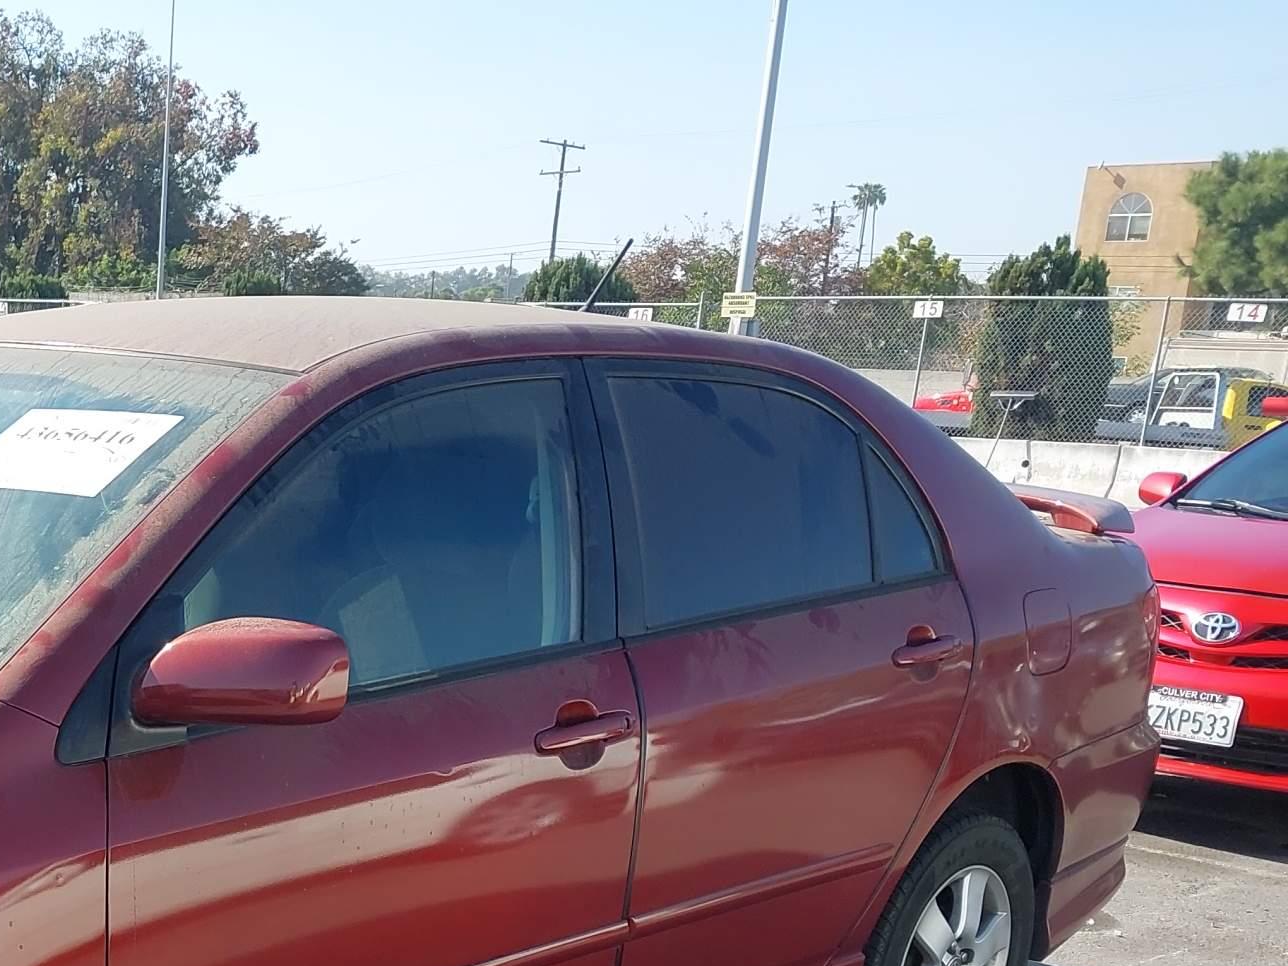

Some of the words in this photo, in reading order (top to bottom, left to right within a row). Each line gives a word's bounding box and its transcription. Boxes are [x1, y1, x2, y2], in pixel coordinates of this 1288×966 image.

[634, 309, 649, 320] 16
[920, 302, 938, 317] 15
[1237, 304, 1260, 320] 14
[1161, 686, 1198, 700] CULVER
[1199, 692, 1222, 703] CITY
[1149, 704, 1230, 739] ZKP533
